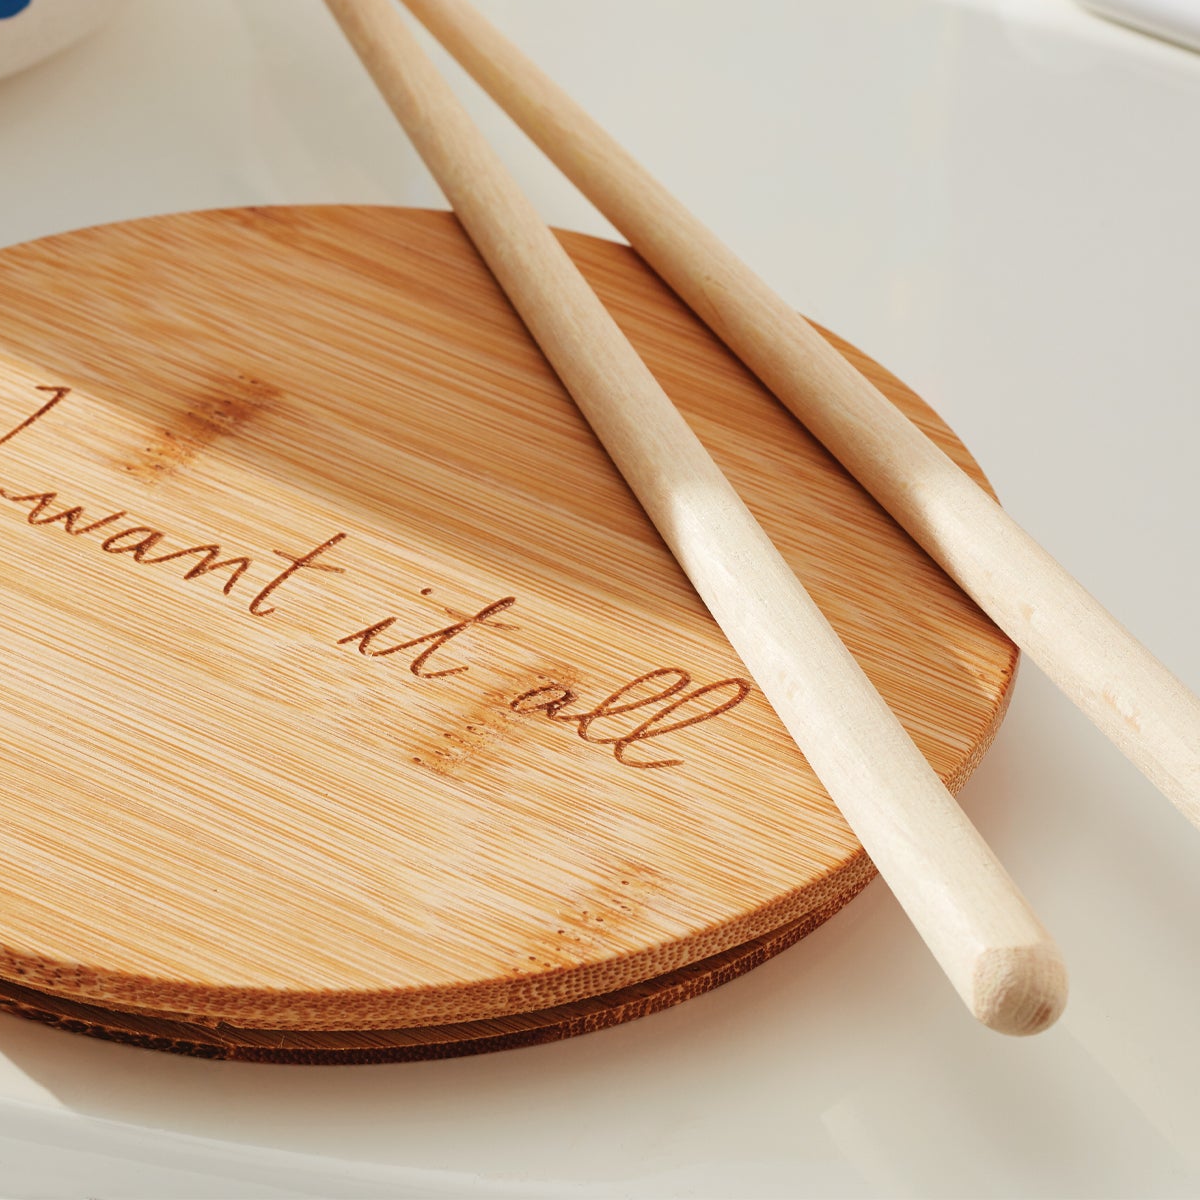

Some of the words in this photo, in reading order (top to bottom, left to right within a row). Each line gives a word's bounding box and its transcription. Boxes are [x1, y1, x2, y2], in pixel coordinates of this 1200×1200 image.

[0, 488, 346, 617] want
[338, 587, 525, 680] it
[510, 668, 751, 769] all
